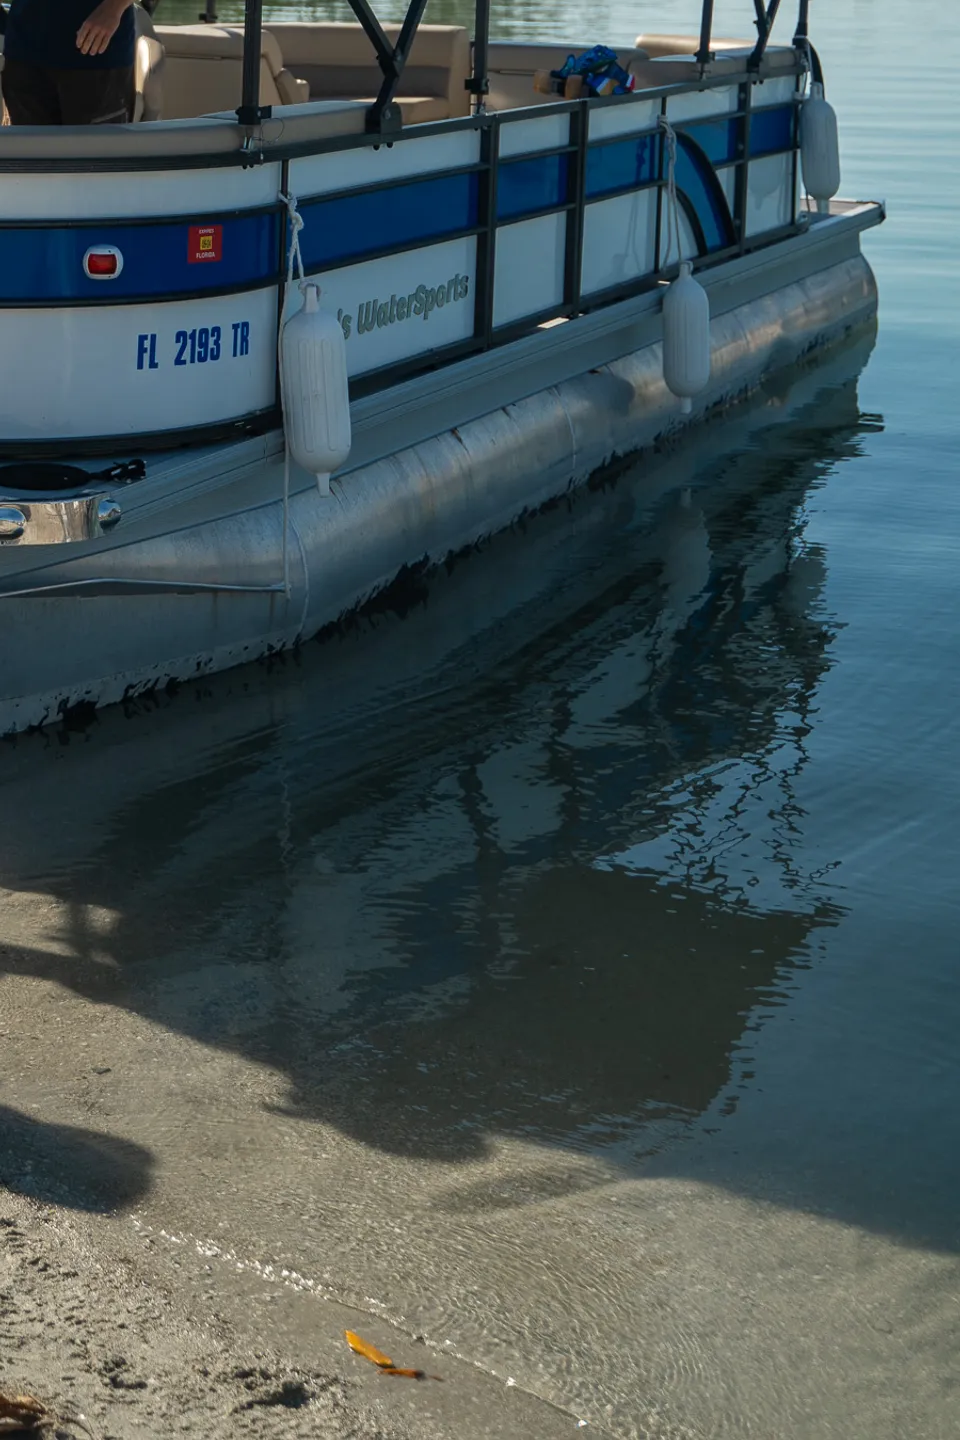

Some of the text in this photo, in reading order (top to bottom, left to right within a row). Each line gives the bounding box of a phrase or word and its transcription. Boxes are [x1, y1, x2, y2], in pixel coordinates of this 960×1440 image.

[357, 273, 469, 335] WaterSports
[137, 321, 250, 370] FL 2193 TR
